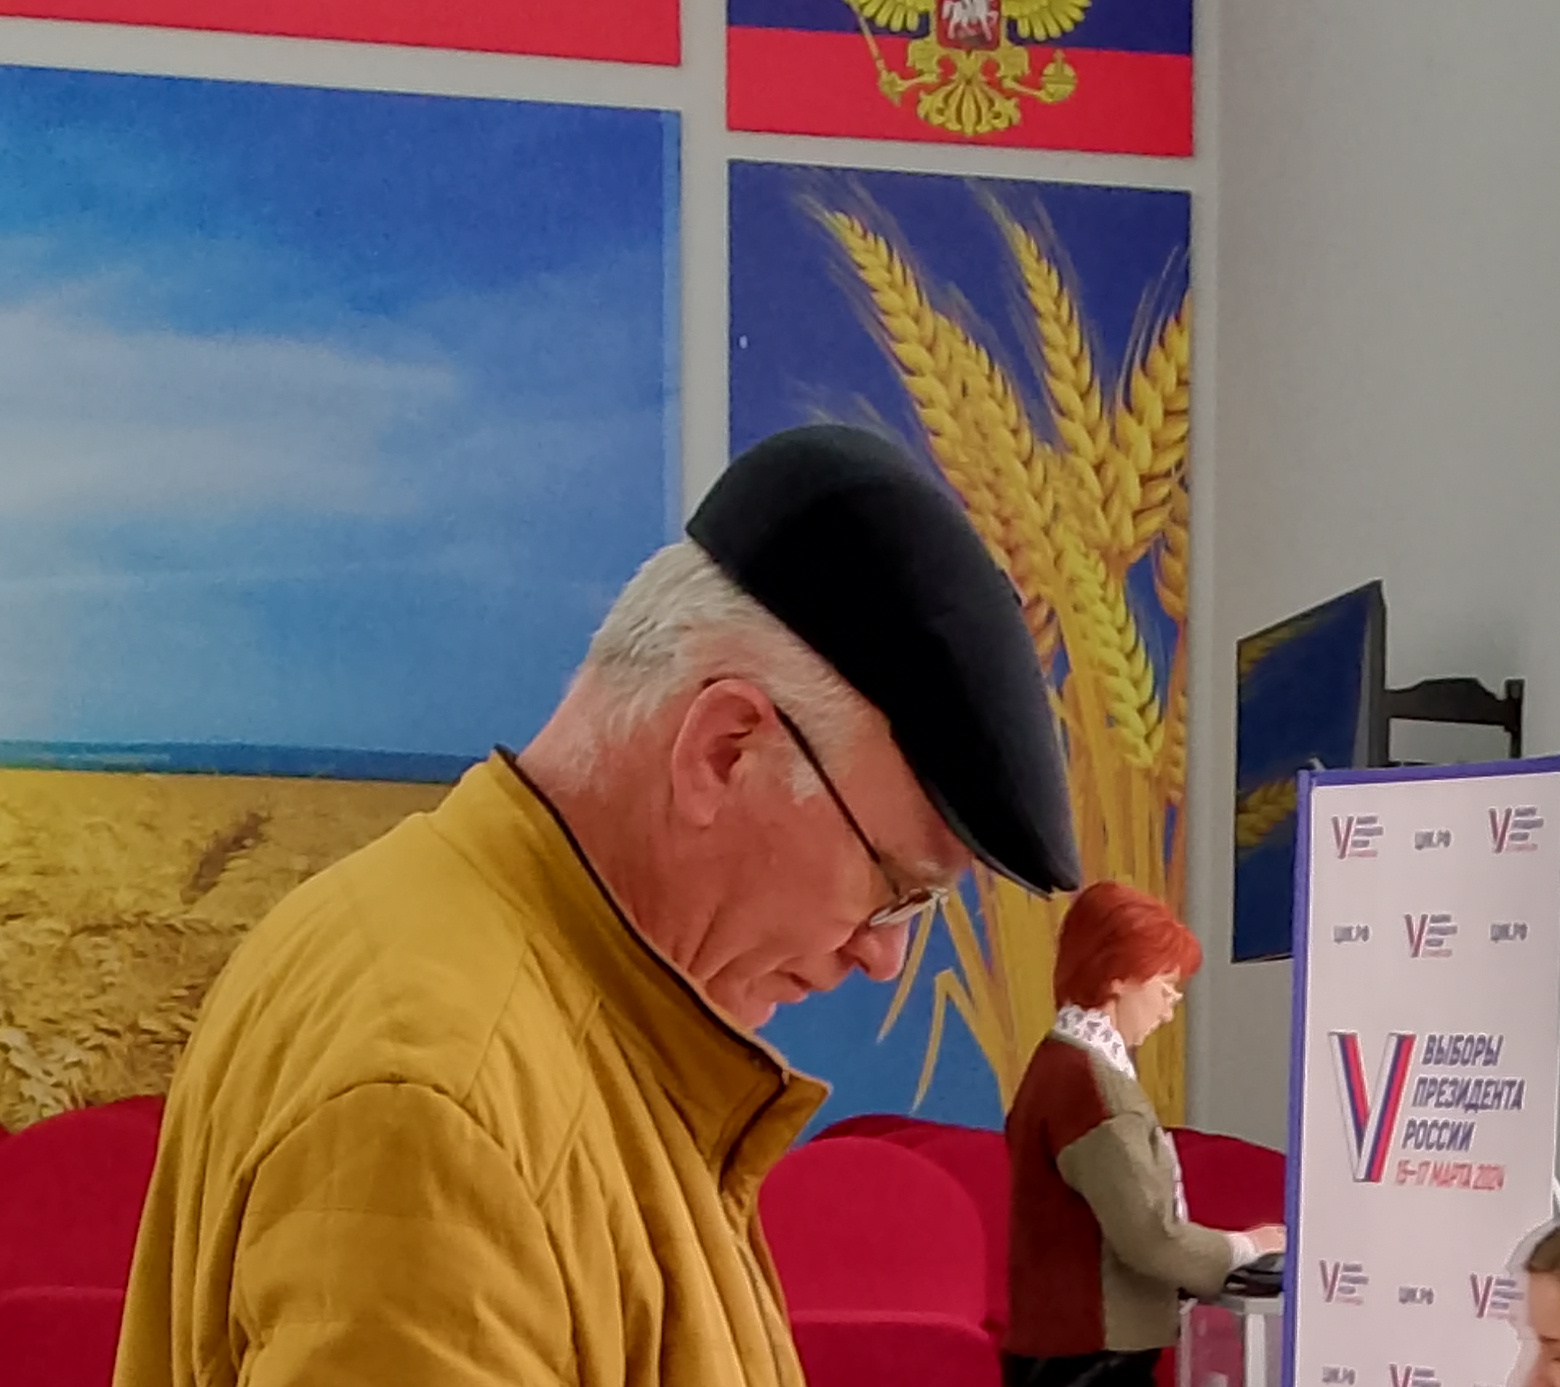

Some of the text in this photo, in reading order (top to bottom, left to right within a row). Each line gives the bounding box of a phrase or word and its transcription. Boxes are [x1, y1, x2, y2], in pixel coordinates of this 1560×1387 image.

[1421, 1034, 1504, 1067] ВЫБОРЫ
[1411, 1077, 1526, 1113] ПРЕЗИДЕНТА
[1402, 1118, 1476, 1151] РОССИИ
